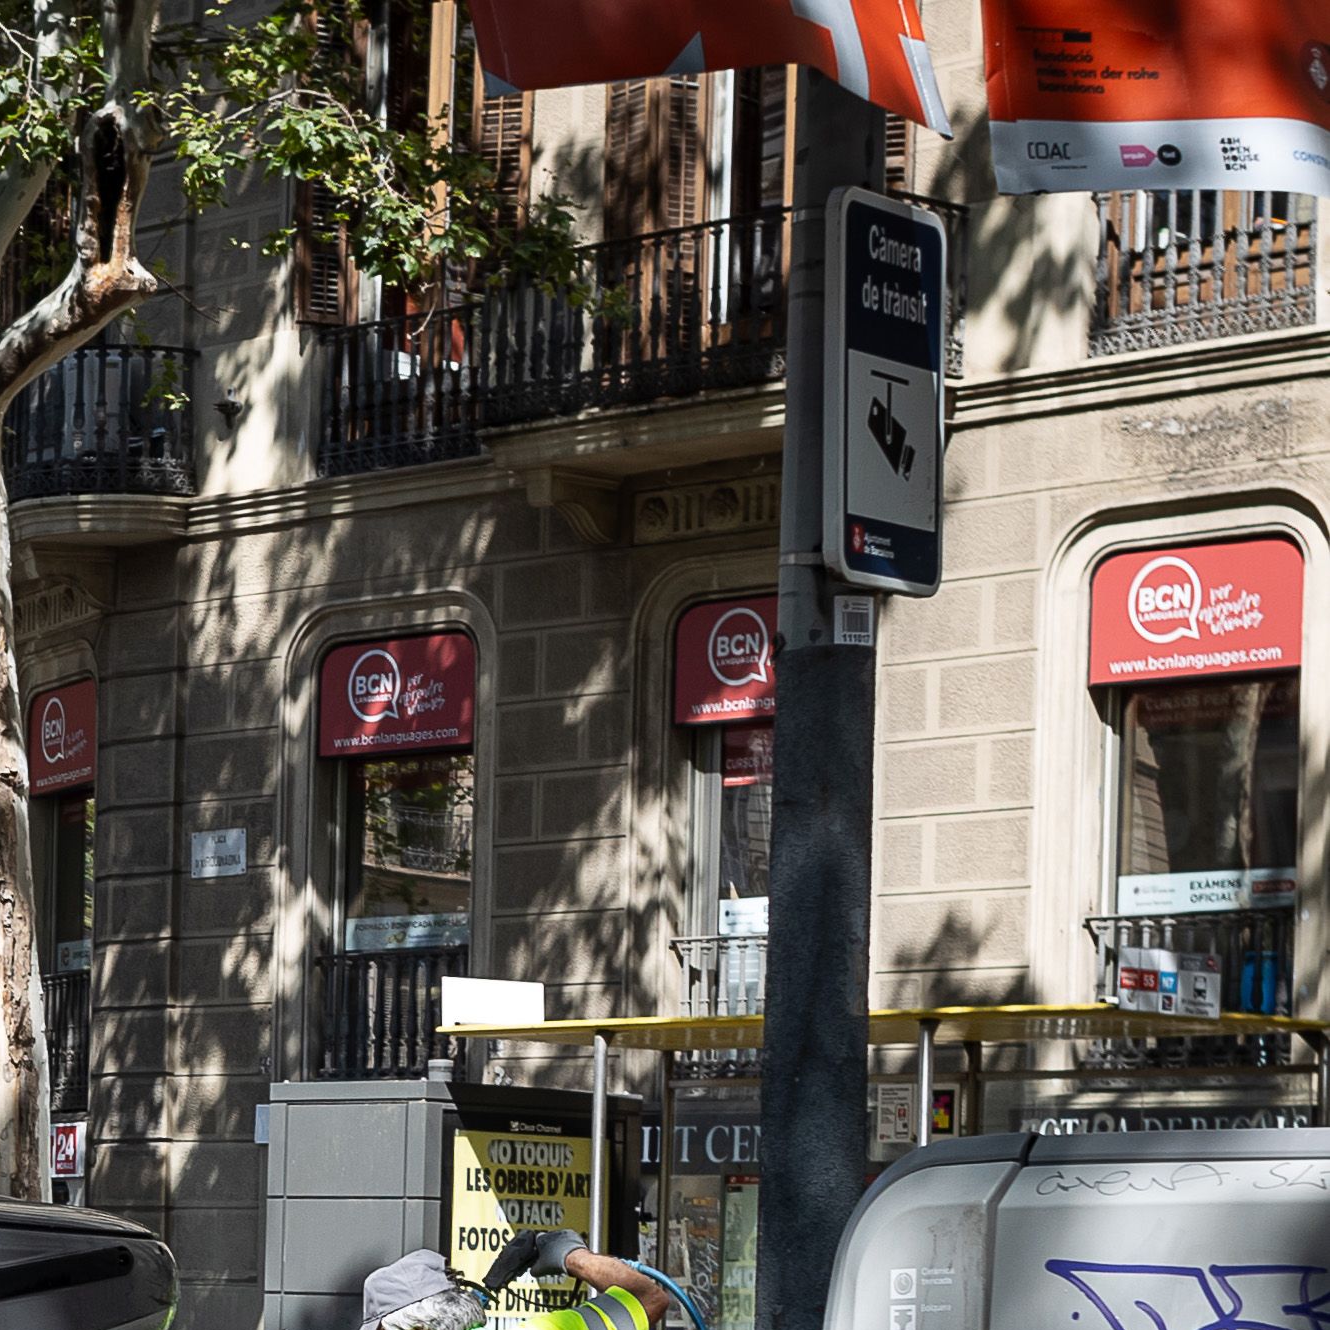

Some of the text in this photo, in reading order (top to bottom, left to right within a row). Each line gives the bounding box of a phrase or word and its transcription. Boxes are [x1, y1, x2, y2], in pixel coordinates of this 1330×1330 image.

[1100, 65, 1123, 79] der
[869, 224, 922, 273] Càmera
[862, 275, 927, 325] de trànsit
[1138, 583, 1191, 613] BCN
[716, 632, 760, 657] BCN
[1109, 646, 1282, 674] www.bcnlanguages.com
[355, 673, 393, 695] BCN
[44, 718, 62, 739] BCN
[333, 727, 459, 749] www.bcnlanguages.com
[1189, 878, 1242, 890] EXÀMENS
[57, 1133, 75, 1160] 24
[489, 1140, 574, 1168] NO TOQUIS
[466, 1168, 492, 1192] LES
[494, 1168, 545, 1196] OBRES
[522, 1201, 565, 1226] FACIS
